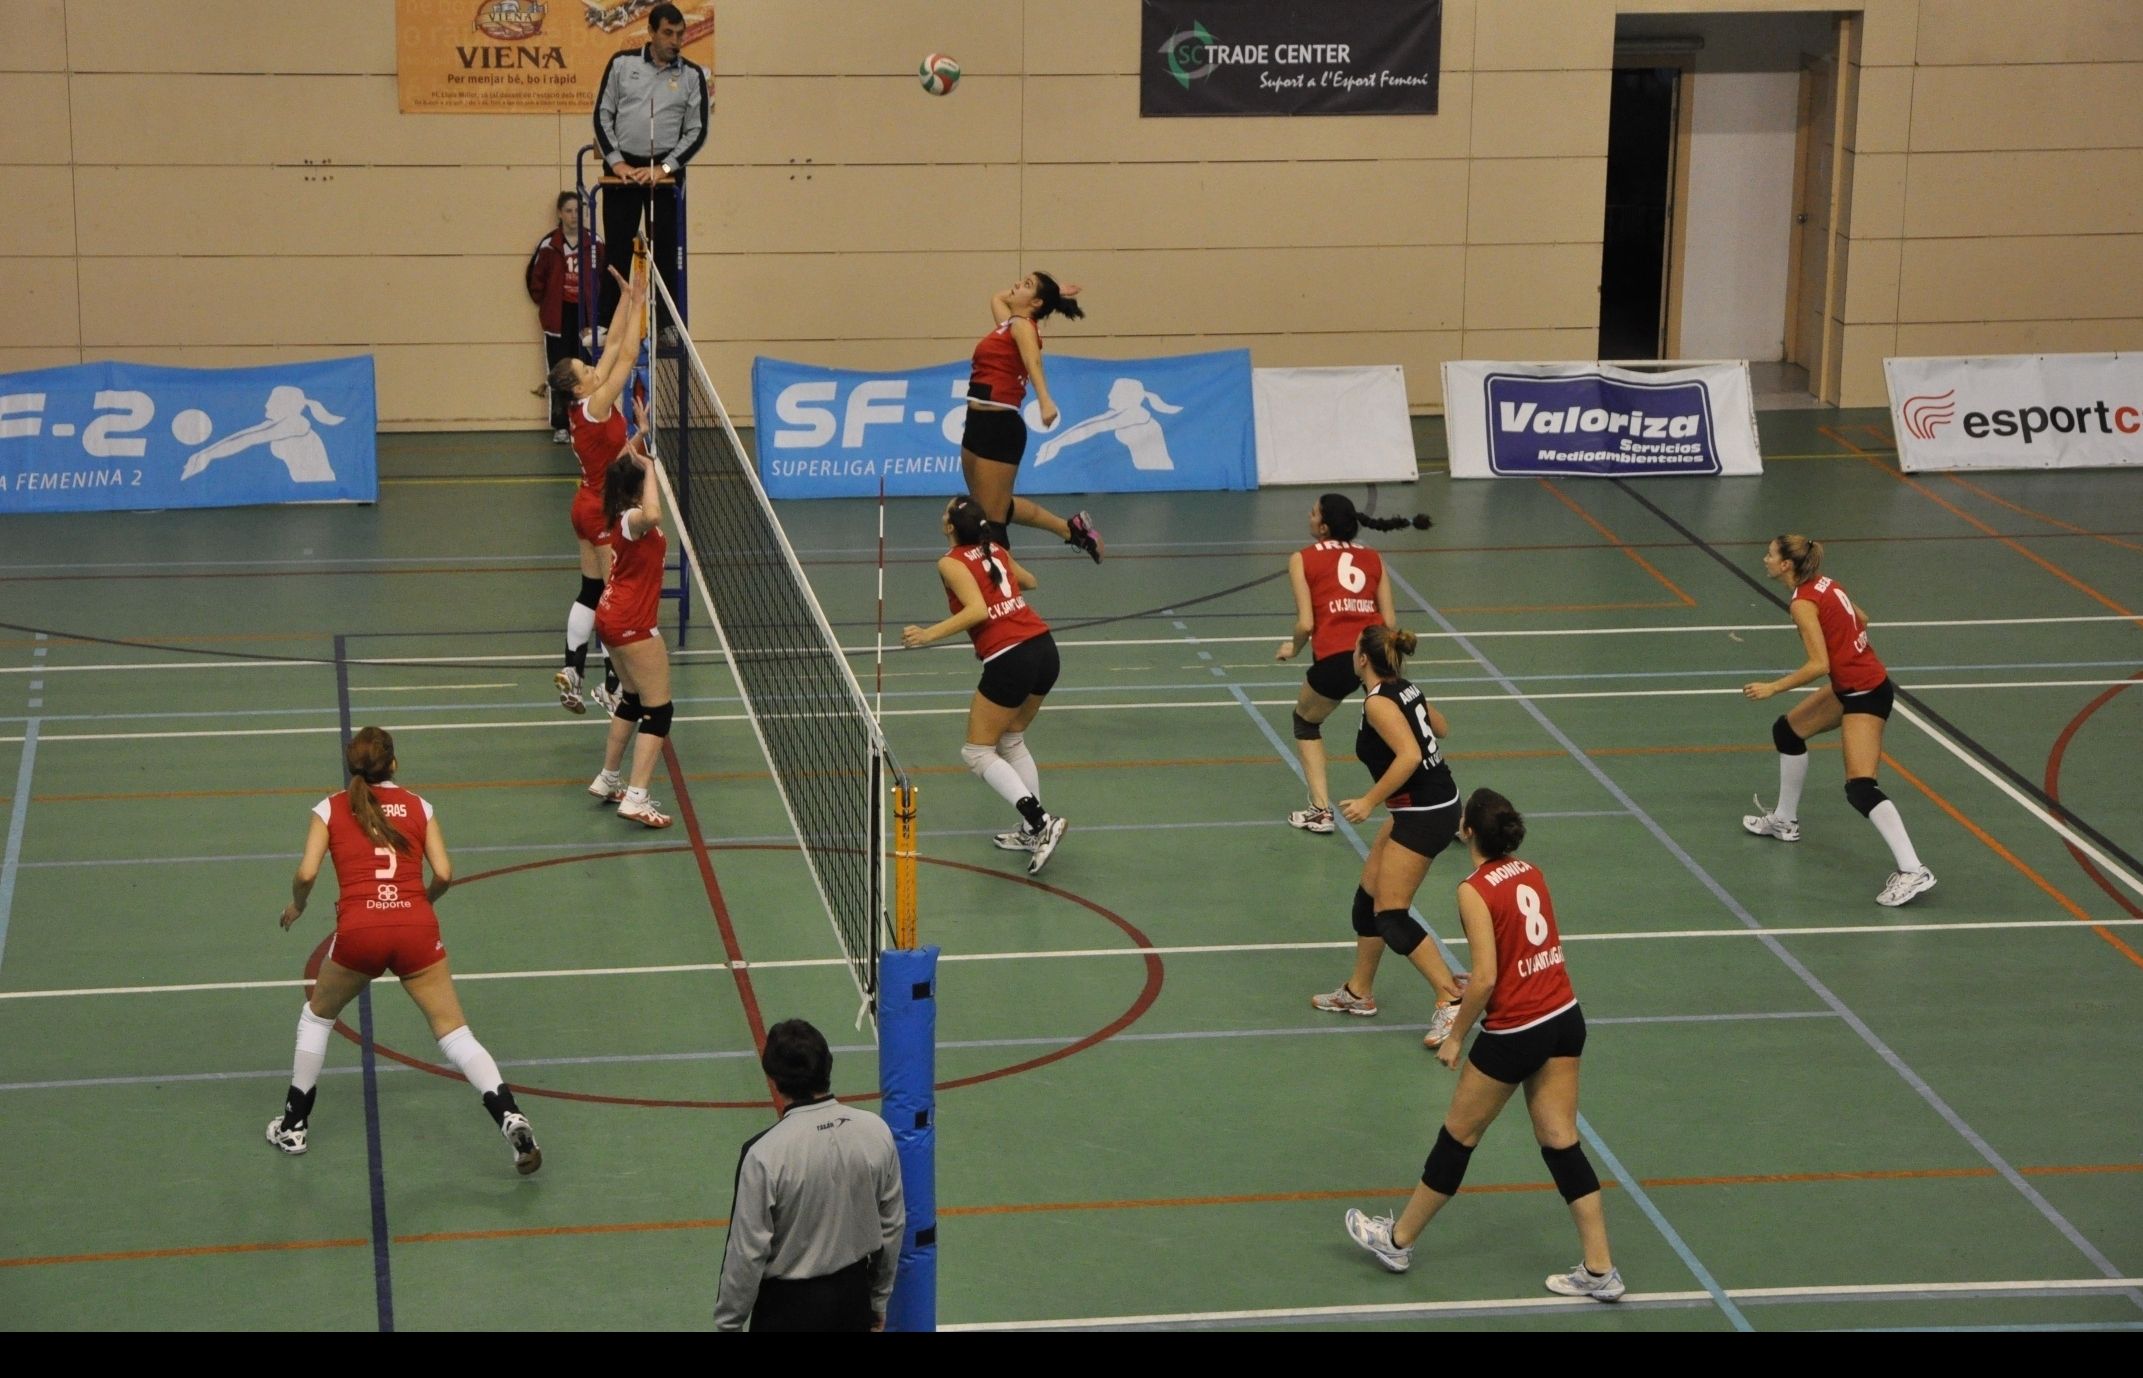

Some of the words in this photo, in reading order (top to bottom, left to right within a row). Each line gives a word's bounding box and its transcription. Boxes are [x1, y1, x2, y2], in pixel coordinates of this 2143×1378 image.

[488, 12, 534, 24] VIENA
[456, 46, 567, 69] VIENA
[1204, 44, 1269, 64] TRADE
[1274, 44, 1351, 64] CENTER
[448, 74, 464, 84] Per
[468, 73, 504, 86] menjar
[527, 74, 540, 84] bo
[549, 73, 577, 86] ràpid
[1260, 71, 1304, 93] Suport
[1307, 78, 1316, 87] a
[1320, 71, 1377, 92] l'Esport
[1380, 70, 1428, 88] Femení
[1499, 401, 1700, 438] Valoriza
[1619, 438, 1701, 454] Servicios
[1537, 450, 1703, 464] Medioambientales
[771, 459, 875, 477] SUPERLIGA
[16, 469, 122, 491] FEMENINA
[131, 469, 142, 486] 2
[1337, 552, 1366, 594] 6
[366, 899, 412, 910] Deporte
[1516, 883, 1549, 946] 8
